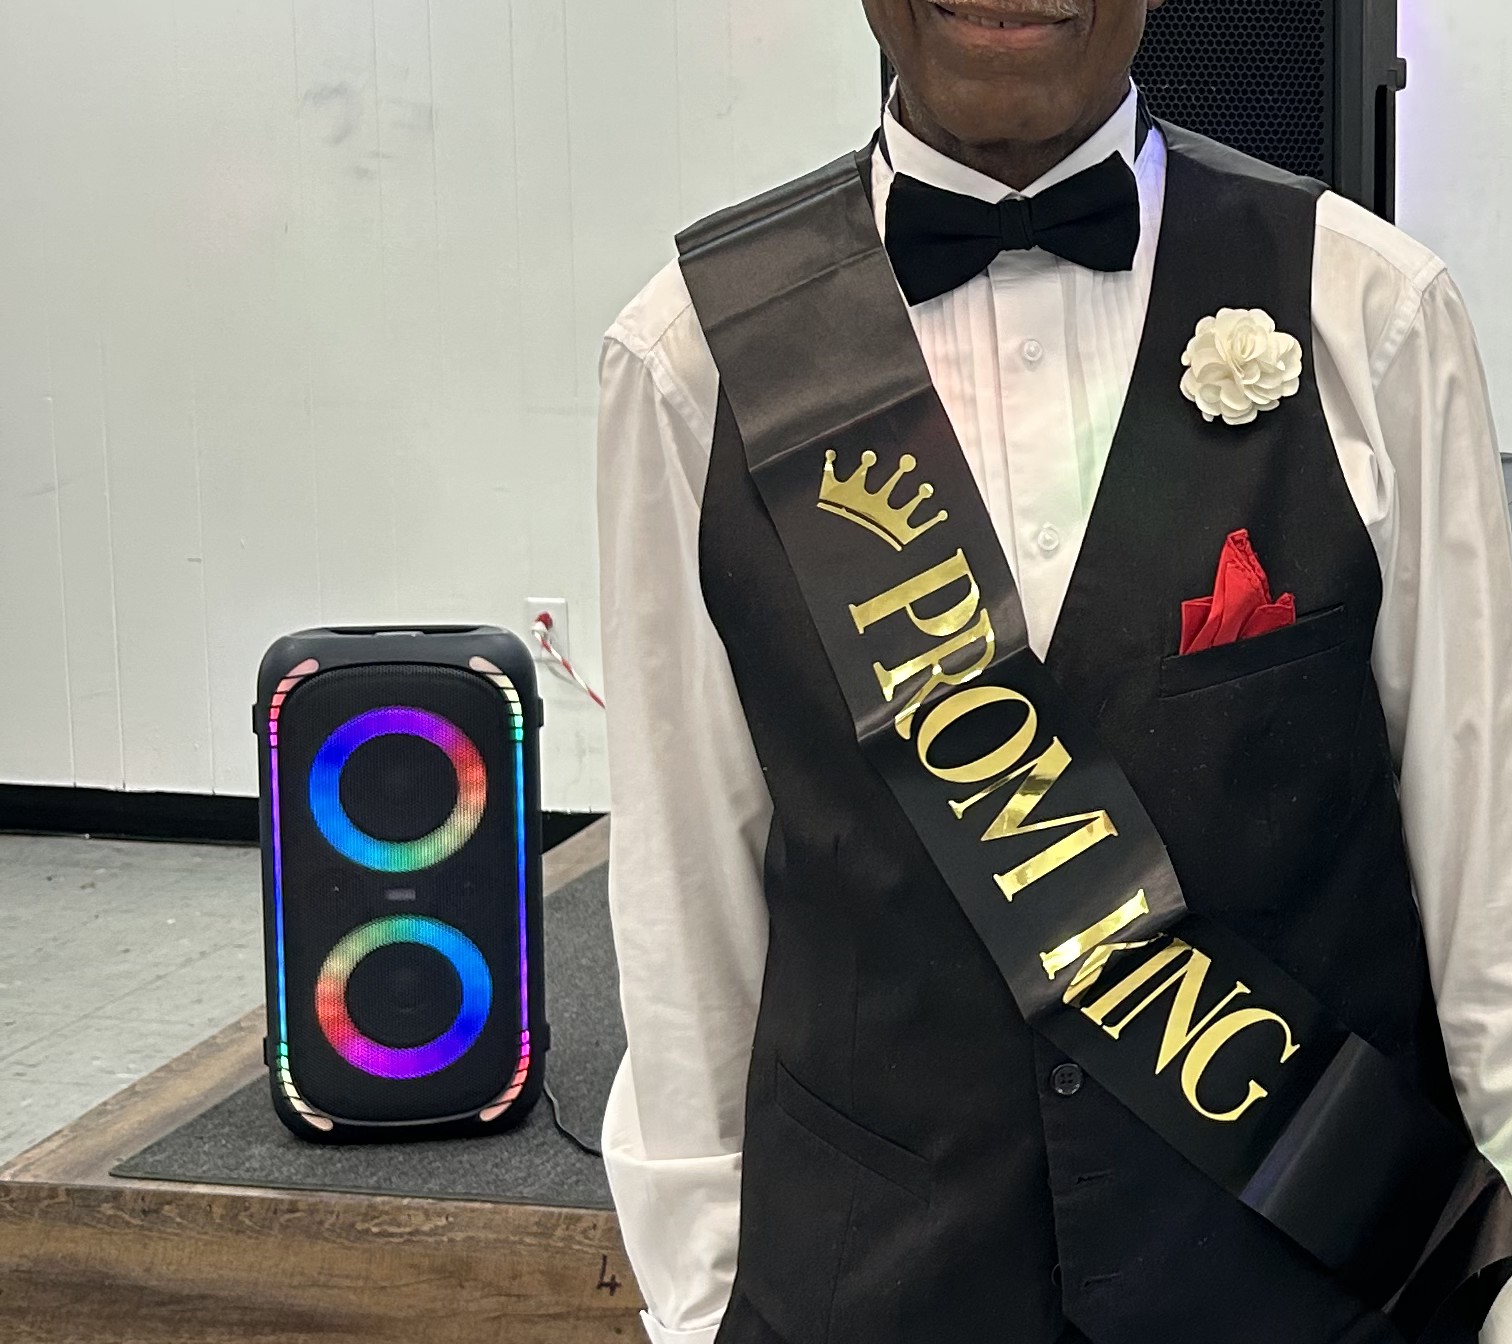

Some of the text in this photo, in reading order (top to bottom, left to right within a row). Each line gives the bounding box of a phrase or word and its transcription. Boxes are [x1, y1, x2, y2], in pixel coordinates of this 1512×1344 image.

[848, 548, 1301, 1122] PROM KING
[596, 1253, 622, 1297] 4
